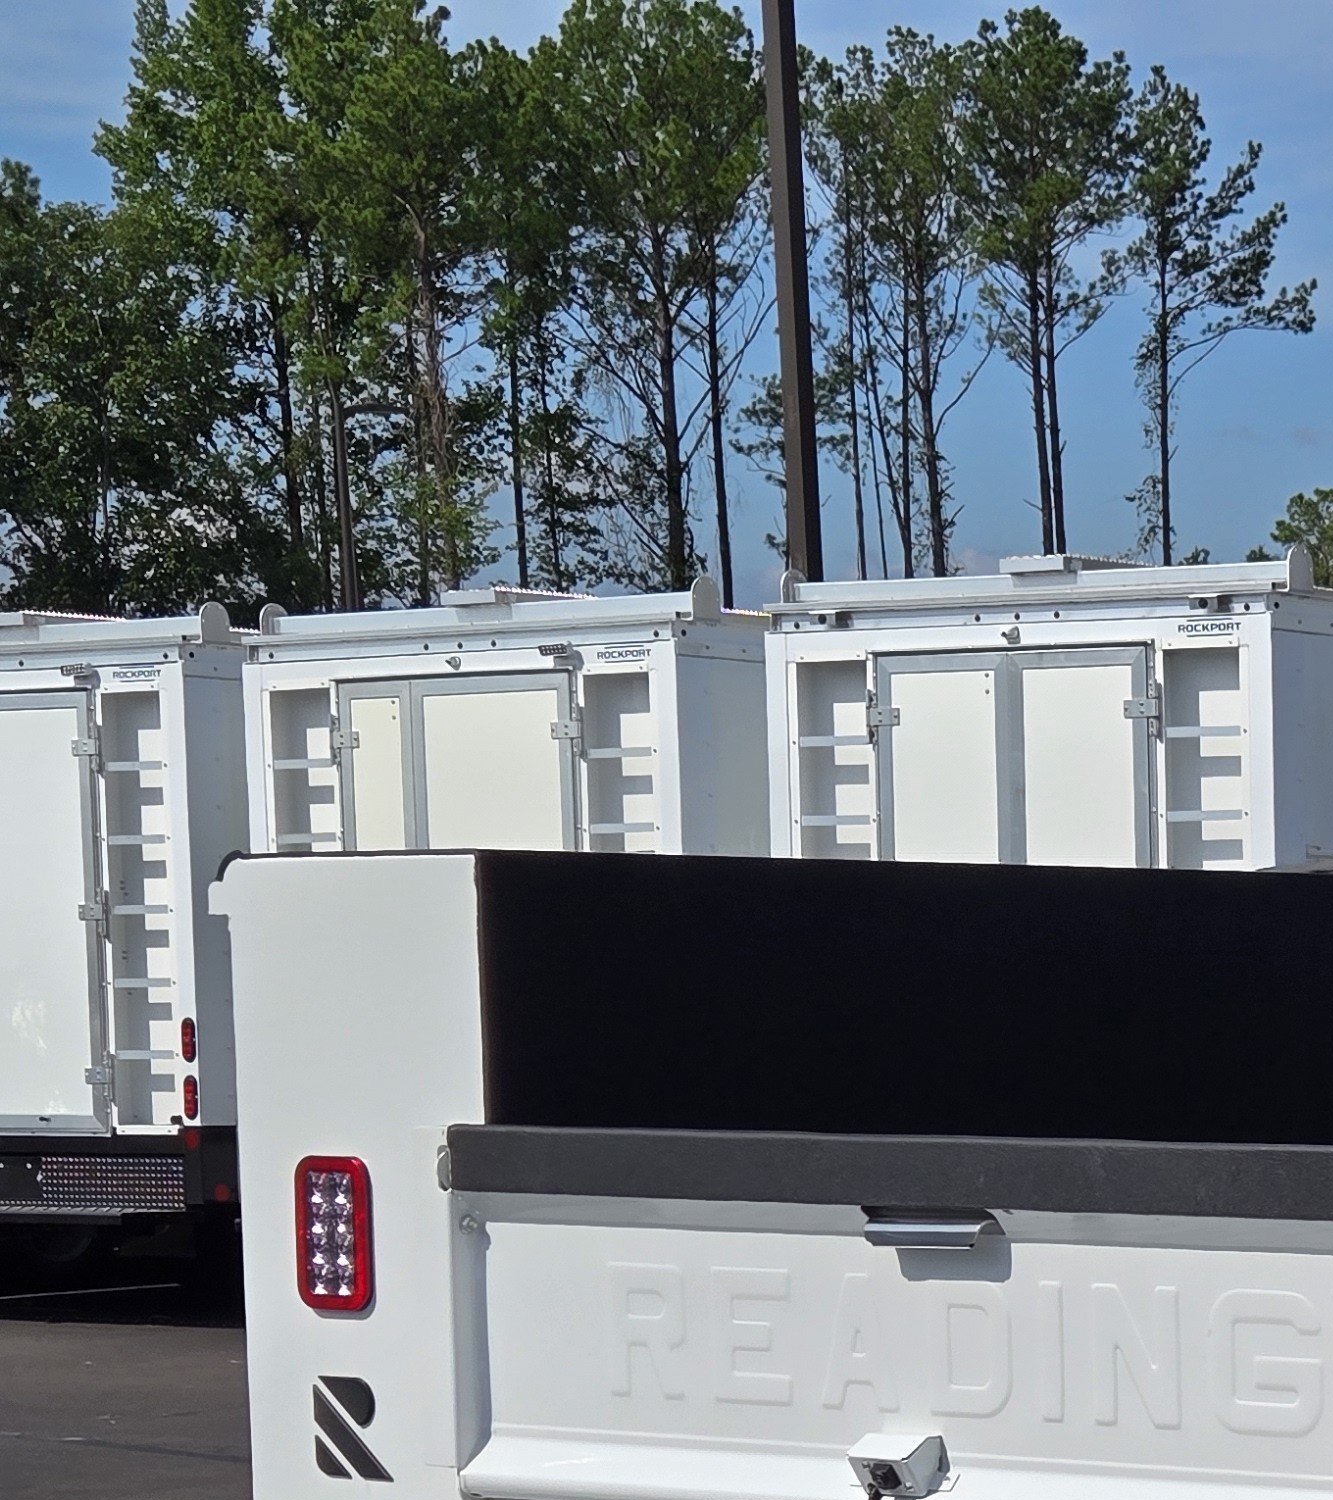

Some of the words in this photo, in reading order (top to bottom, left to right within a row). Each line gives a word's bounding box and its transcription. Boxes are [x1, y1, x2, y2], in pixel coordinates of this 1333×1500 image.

[1178, 622, 1242, 633] ROCKPORT
[597, 649, 652, 660] ROCKPORT
[113, 669, 162, 679] ROCKPORT
[606, 1261, 1326, 1438] READING
